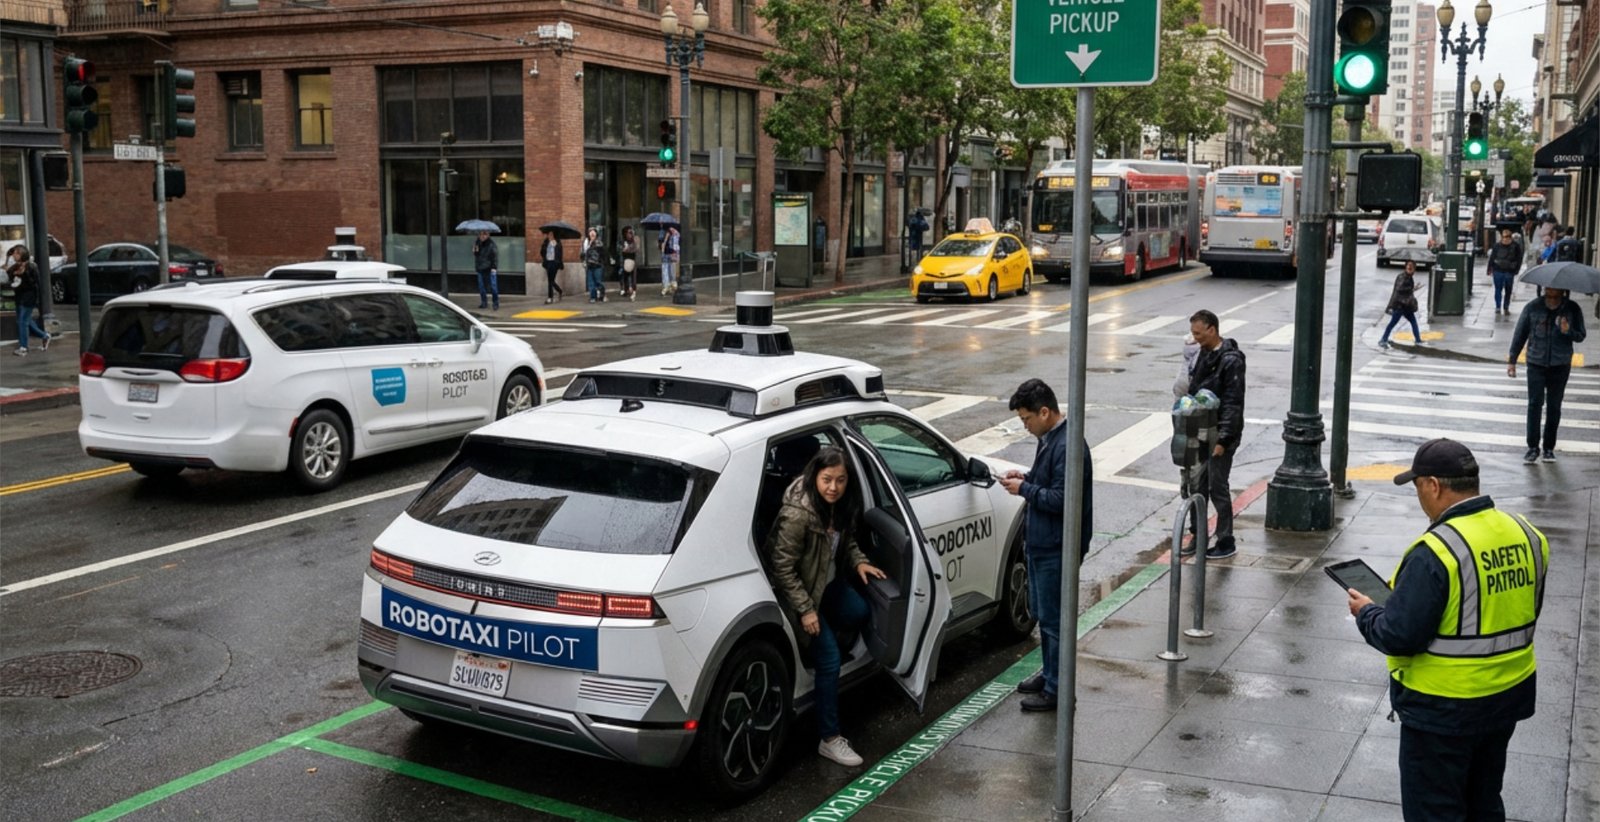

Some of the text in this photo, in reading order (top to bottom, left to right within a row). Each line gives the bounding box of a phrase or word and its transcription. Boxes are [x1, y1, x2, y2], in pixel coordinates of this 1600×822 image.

[1049, 11, 1120, 34] PICKUP
[946, 554, 965, 582] OT
[1480, 543, 1529, 571] SAFETY
[1486, 566, 1534, 595] PATROL
[389, 600, 580, 660] ROBOTAXI PILOT
